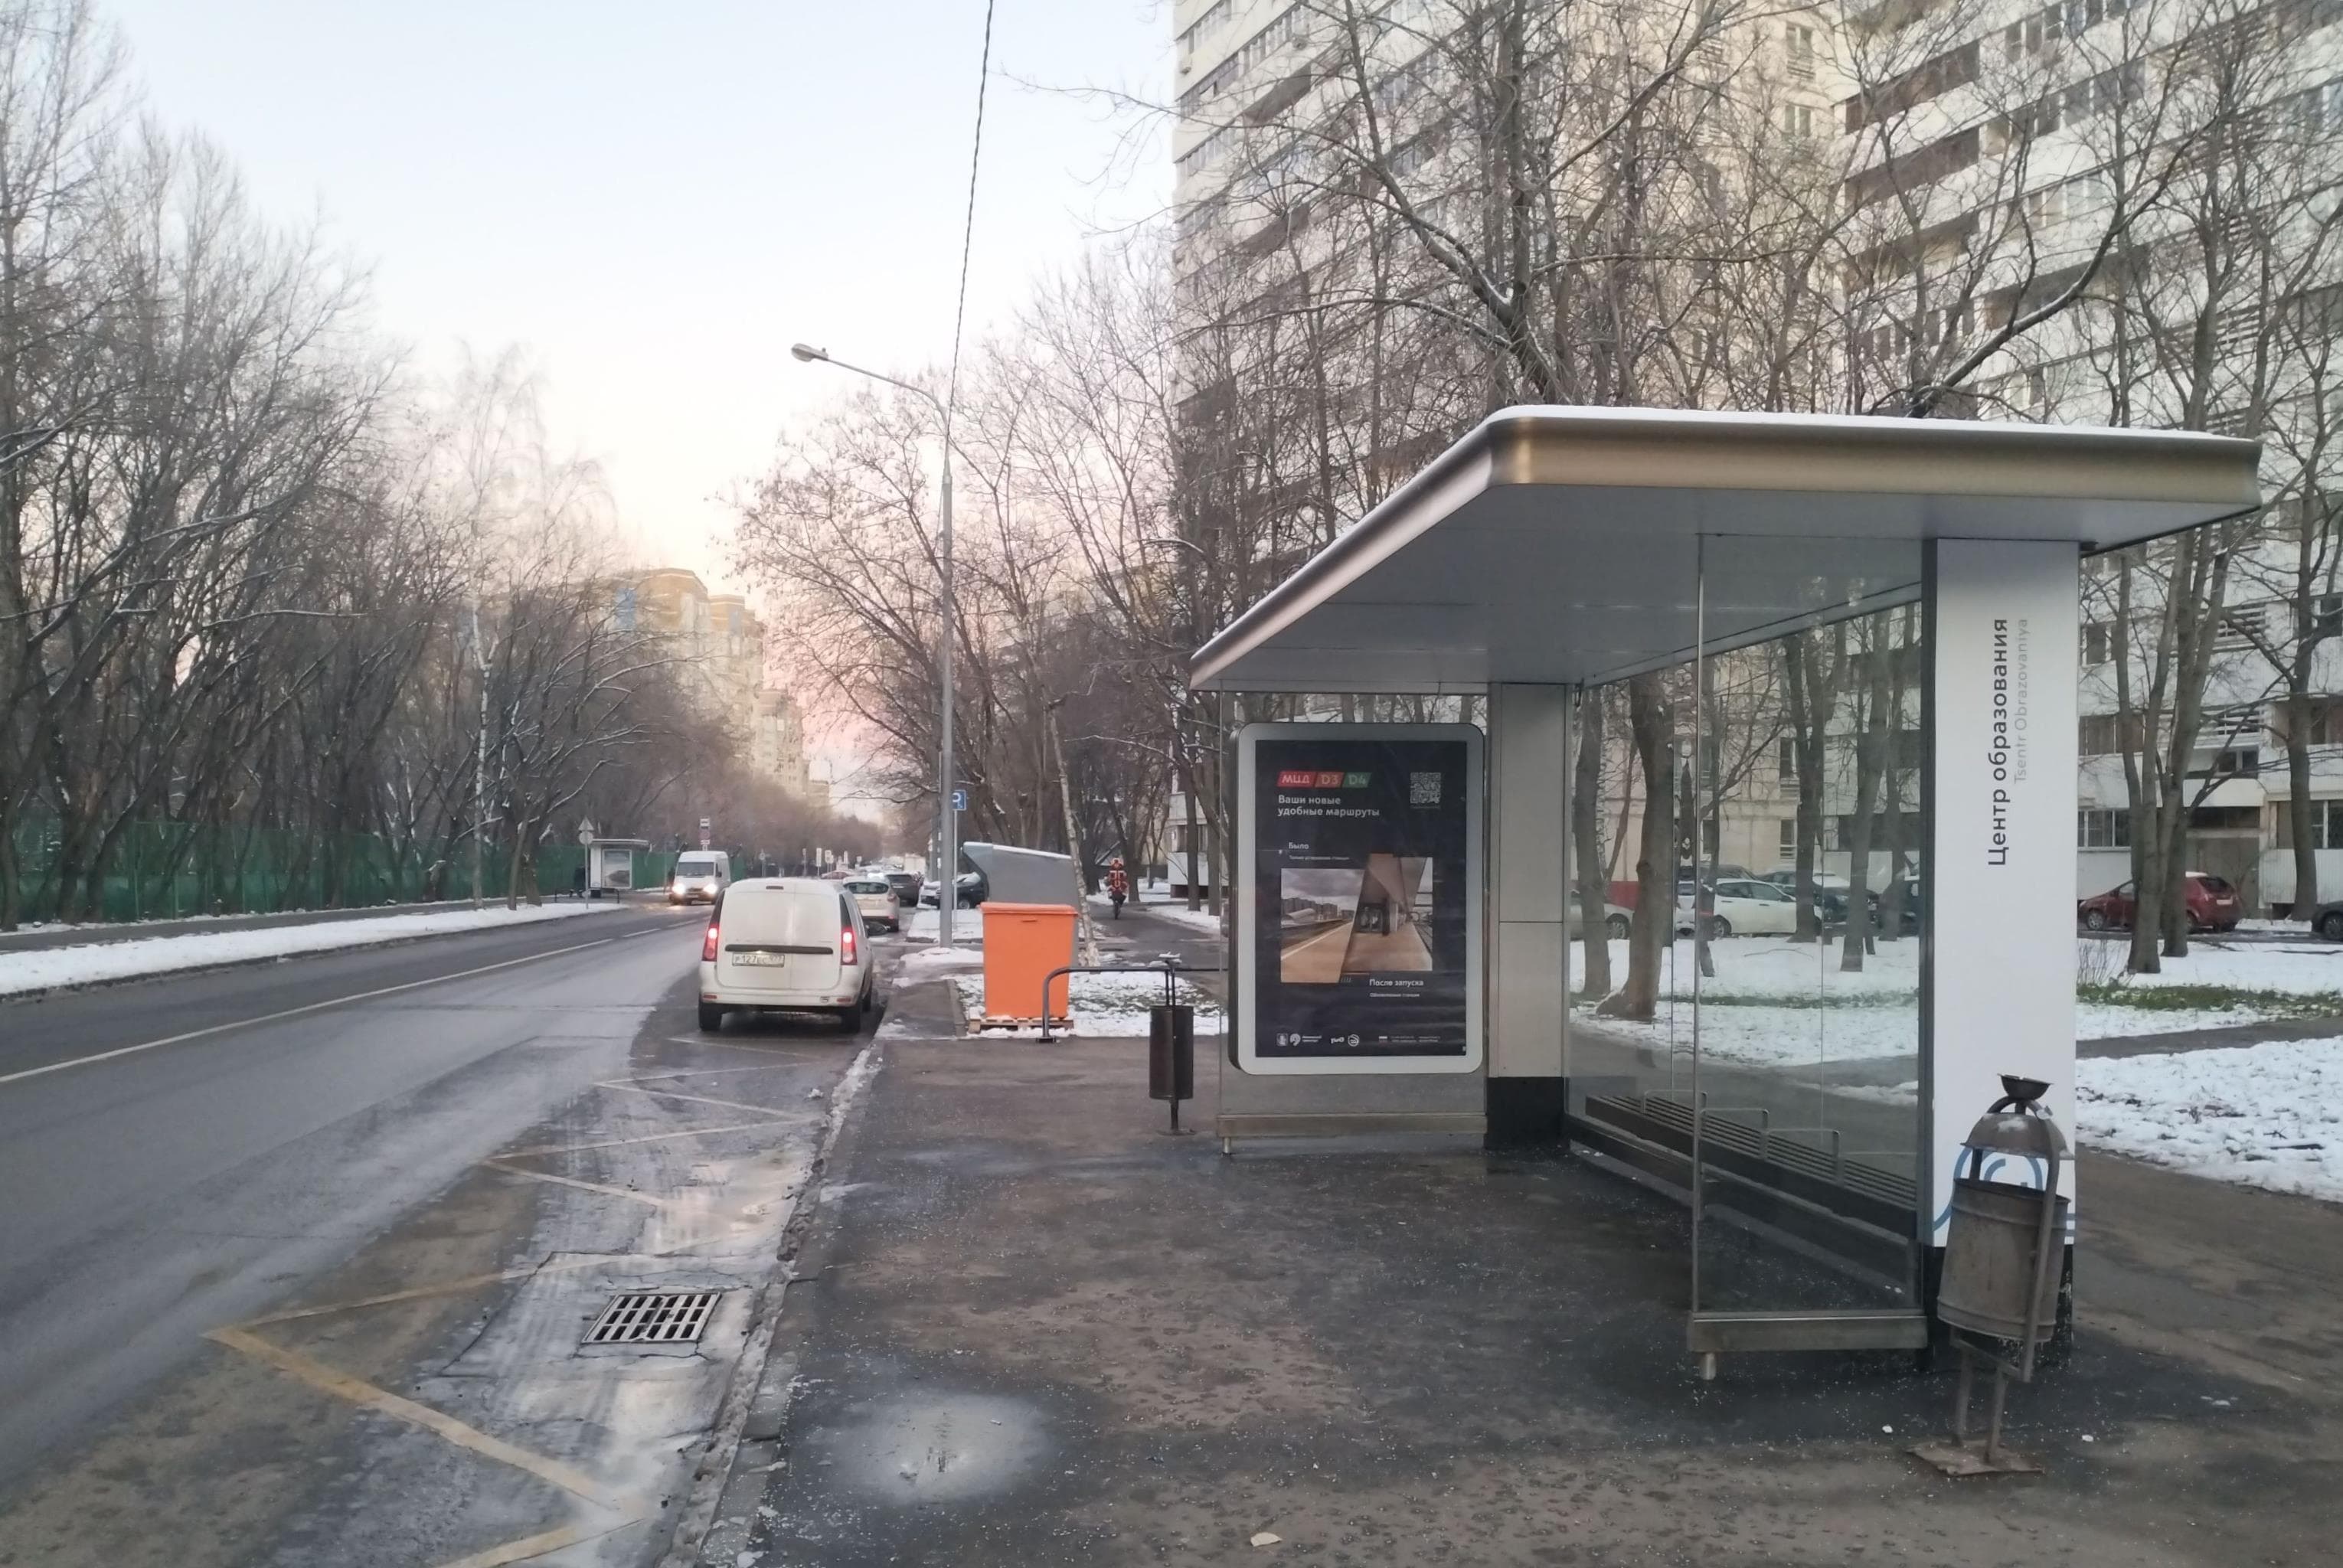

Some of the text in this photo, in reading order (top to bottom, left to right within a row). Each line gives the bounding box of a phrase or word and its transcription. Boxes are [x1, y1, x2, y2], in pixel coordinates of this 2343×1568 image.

[2014, 619, 2031, 785] Tsentr Obrazovaniya
[1988, 619, 2011, 865] Центр образования
[1281, 773, 1368, 786] МЦД D3 D4
[1278, 795, 1307, 804] Ваши
[1277, 806, 1380, 818] удобные маршруты
[1288, 841, 1310, 850] Было
[1368, 978, 1424, 988] После запуска
